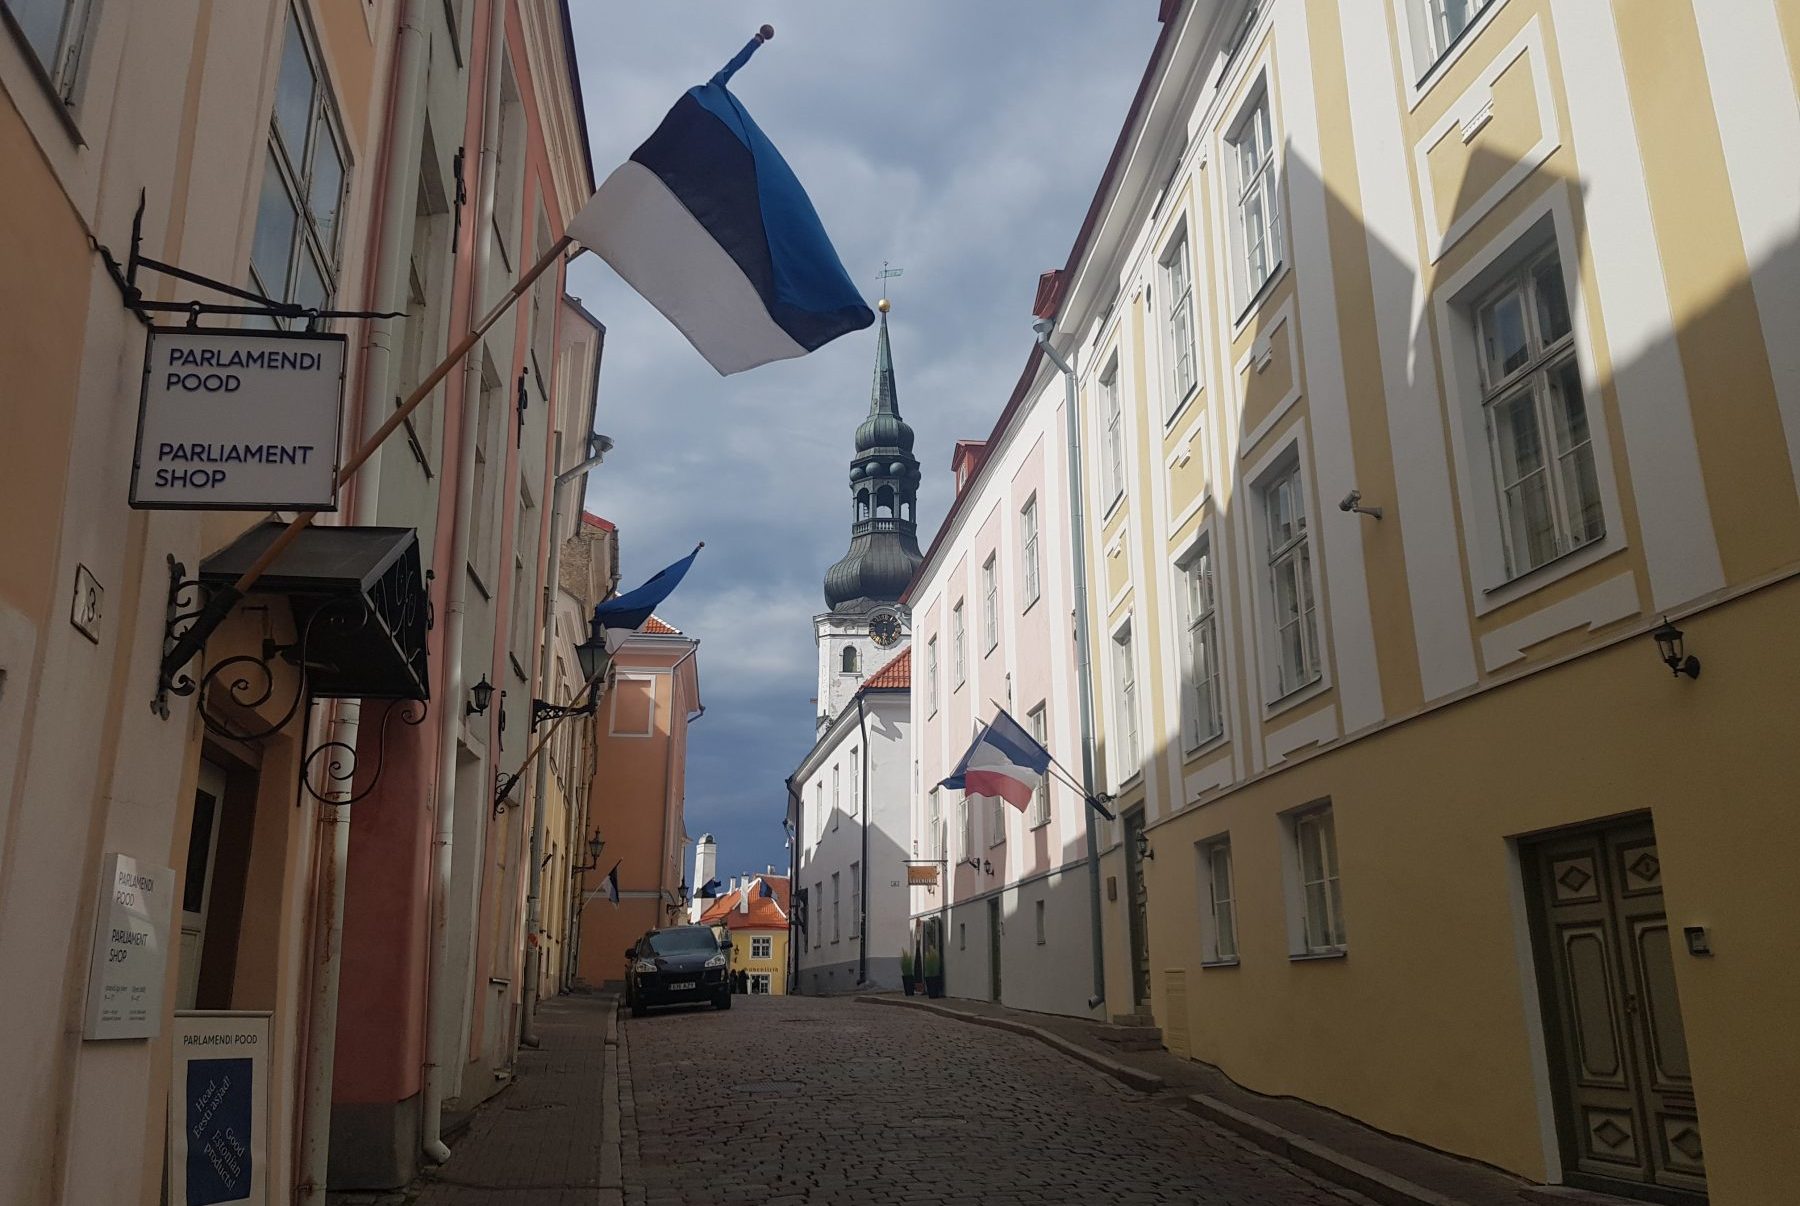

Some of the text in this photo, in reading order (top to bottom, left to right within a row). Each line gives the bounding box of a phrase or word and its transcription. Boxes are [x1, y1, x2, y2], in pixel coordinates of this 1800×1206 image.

[169, 349, 321, 371] PARLAMENDI
[166, 373, 241, 392] POOD
[158, 443, 314, 464] PARLIAMENT
[155, 468, 226, 488] SHOP
[119, 871, 154, 892] PARLAMENDI
[117, 890, 135, 907] POOD
[112, 929, 148, 947] PARLIAMENT
[109, 948, 127, 963] SHOP
[183, 1034, 258, 1045] PARLAMENDI POOD
[195, 1080, 216, 1112] Head
[192, 1111, 213, 1139] Eesti
[225, 1127, 246, 1158] Good
[211, 1130, 242, 1177] Estonian
[203, 1143, 237, 1191] products!
